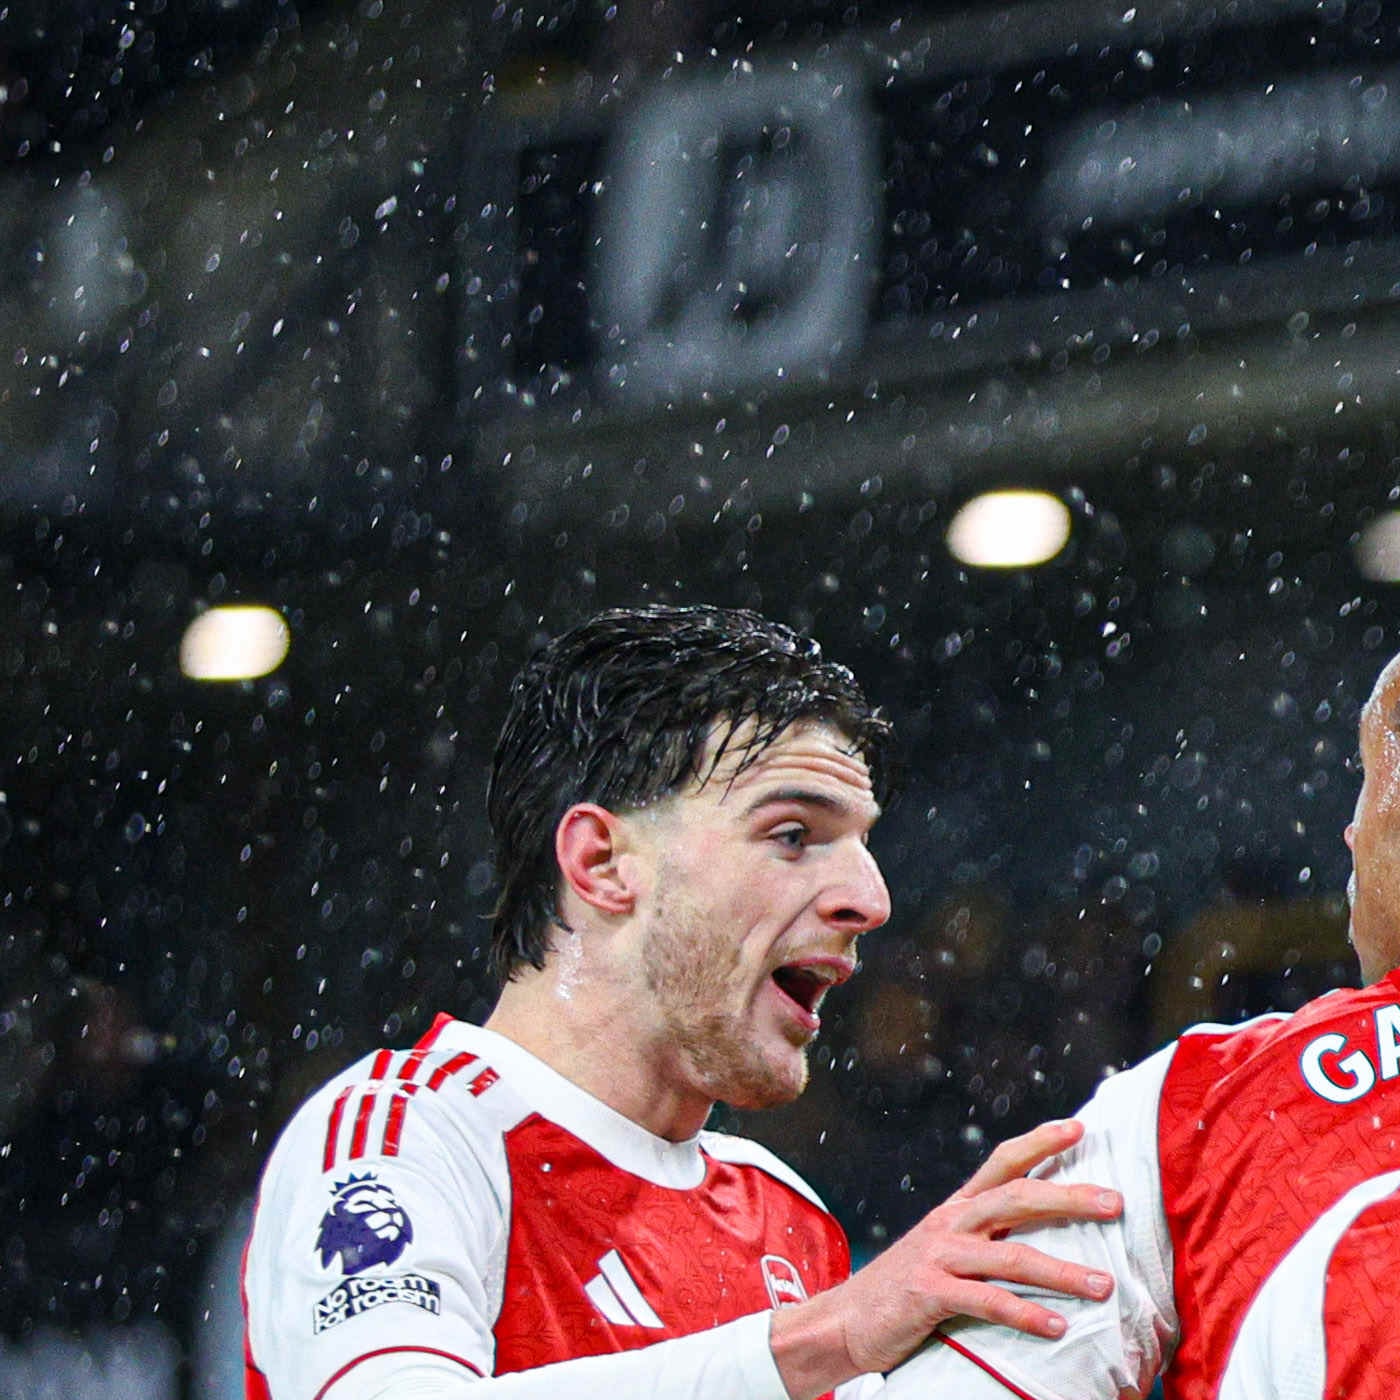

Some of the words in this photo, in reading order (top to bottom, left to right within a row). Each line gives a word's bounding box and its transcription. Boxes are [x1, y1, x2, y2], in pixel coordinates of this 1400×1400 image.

[313, 1288, 349, 1319] No
[348, 1276, 430, 1298] room
[351, 1287, 441, 1316] racism
